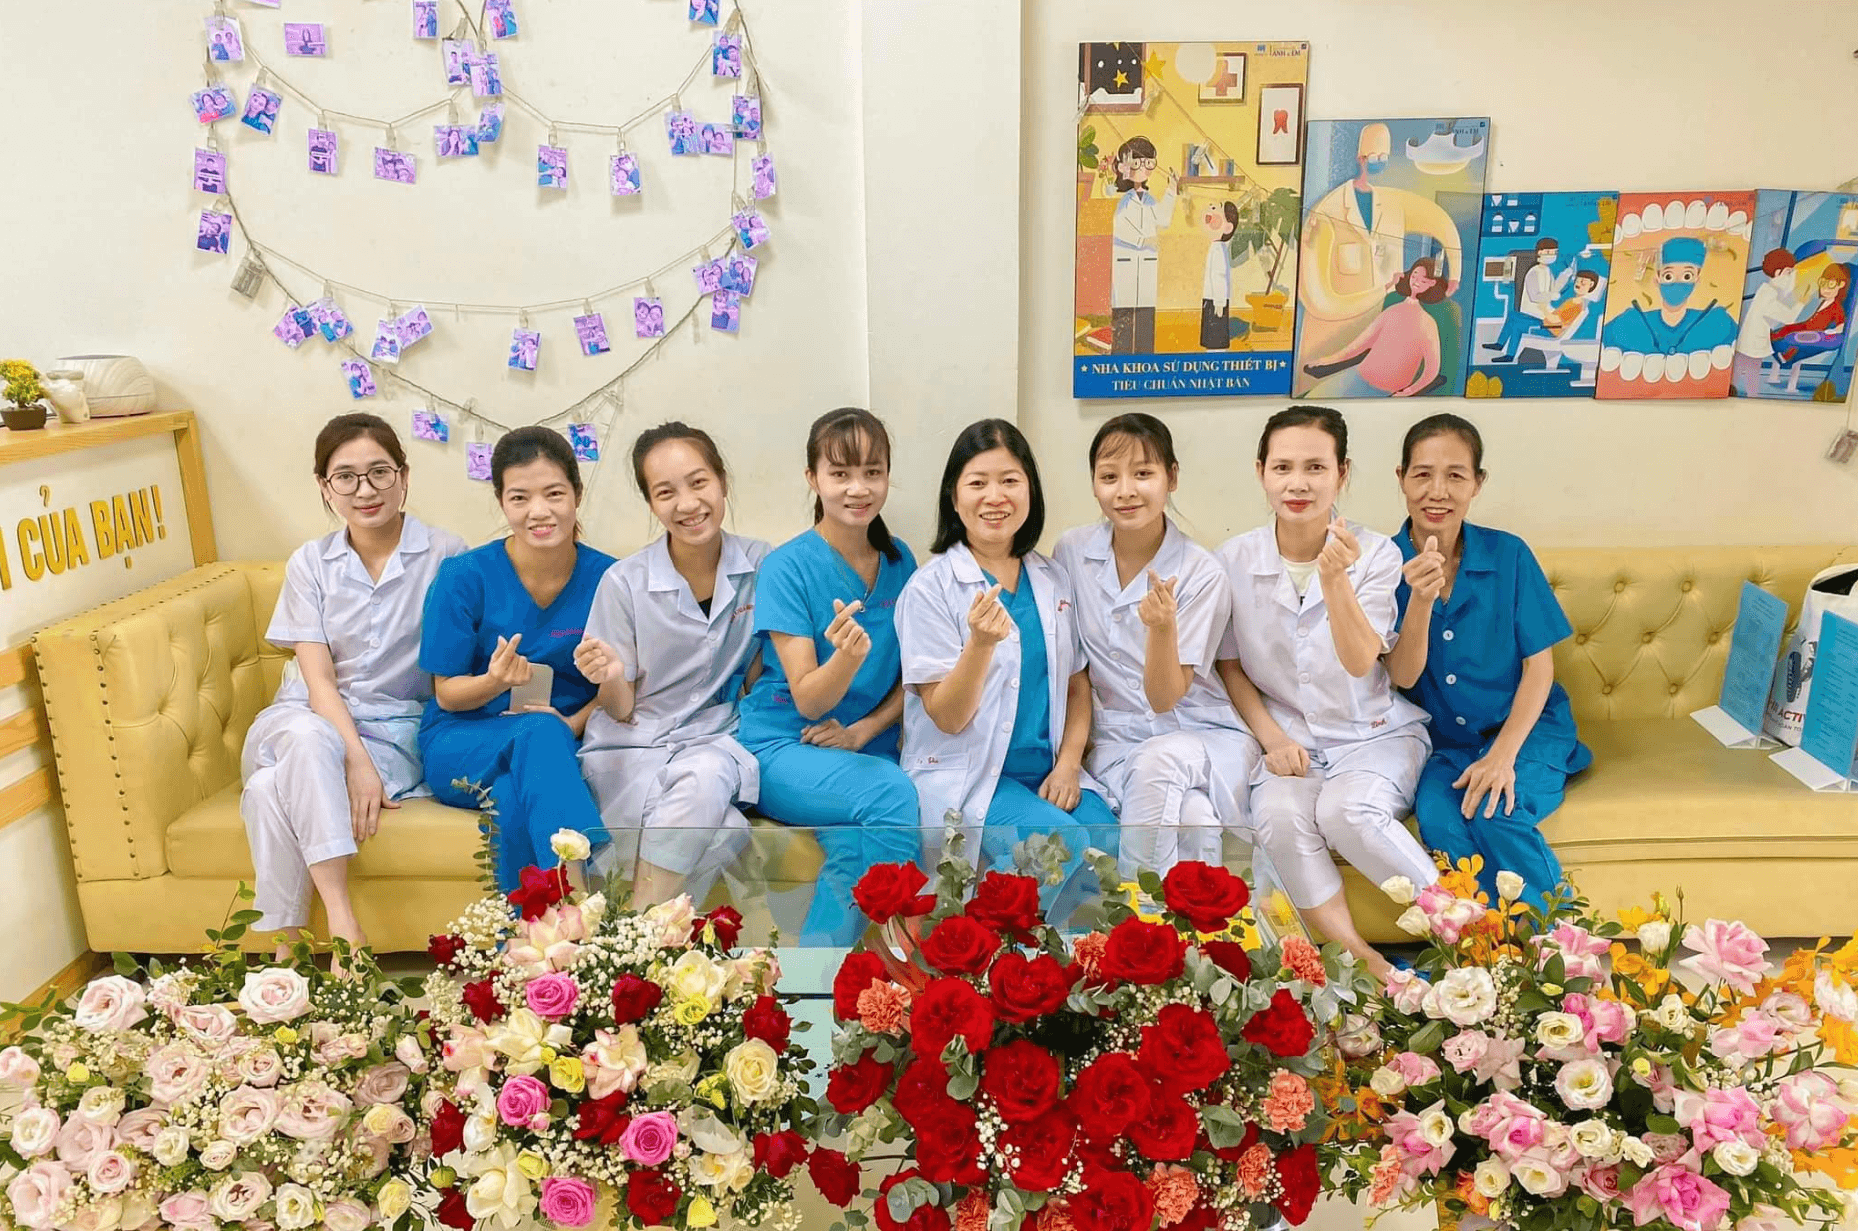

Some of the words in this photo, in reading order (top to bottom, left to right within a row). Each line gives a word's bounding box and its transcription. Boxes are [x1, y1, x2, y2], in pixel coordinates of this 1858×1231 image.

[1092, 363, 1119, 374] NHA
[1123, 362, 1160, 374] KHOA
[1183, 360, 1220, 374] DỤNG
[1222, 357, 1262, 372] THIẾT
[1265, 360, 1278, 372] BỊ
[1189, 376, 1224, 390] NHẬT
[17, 484, 90, 582] CỦA
[89, 484, 167, 569] BẠN!
